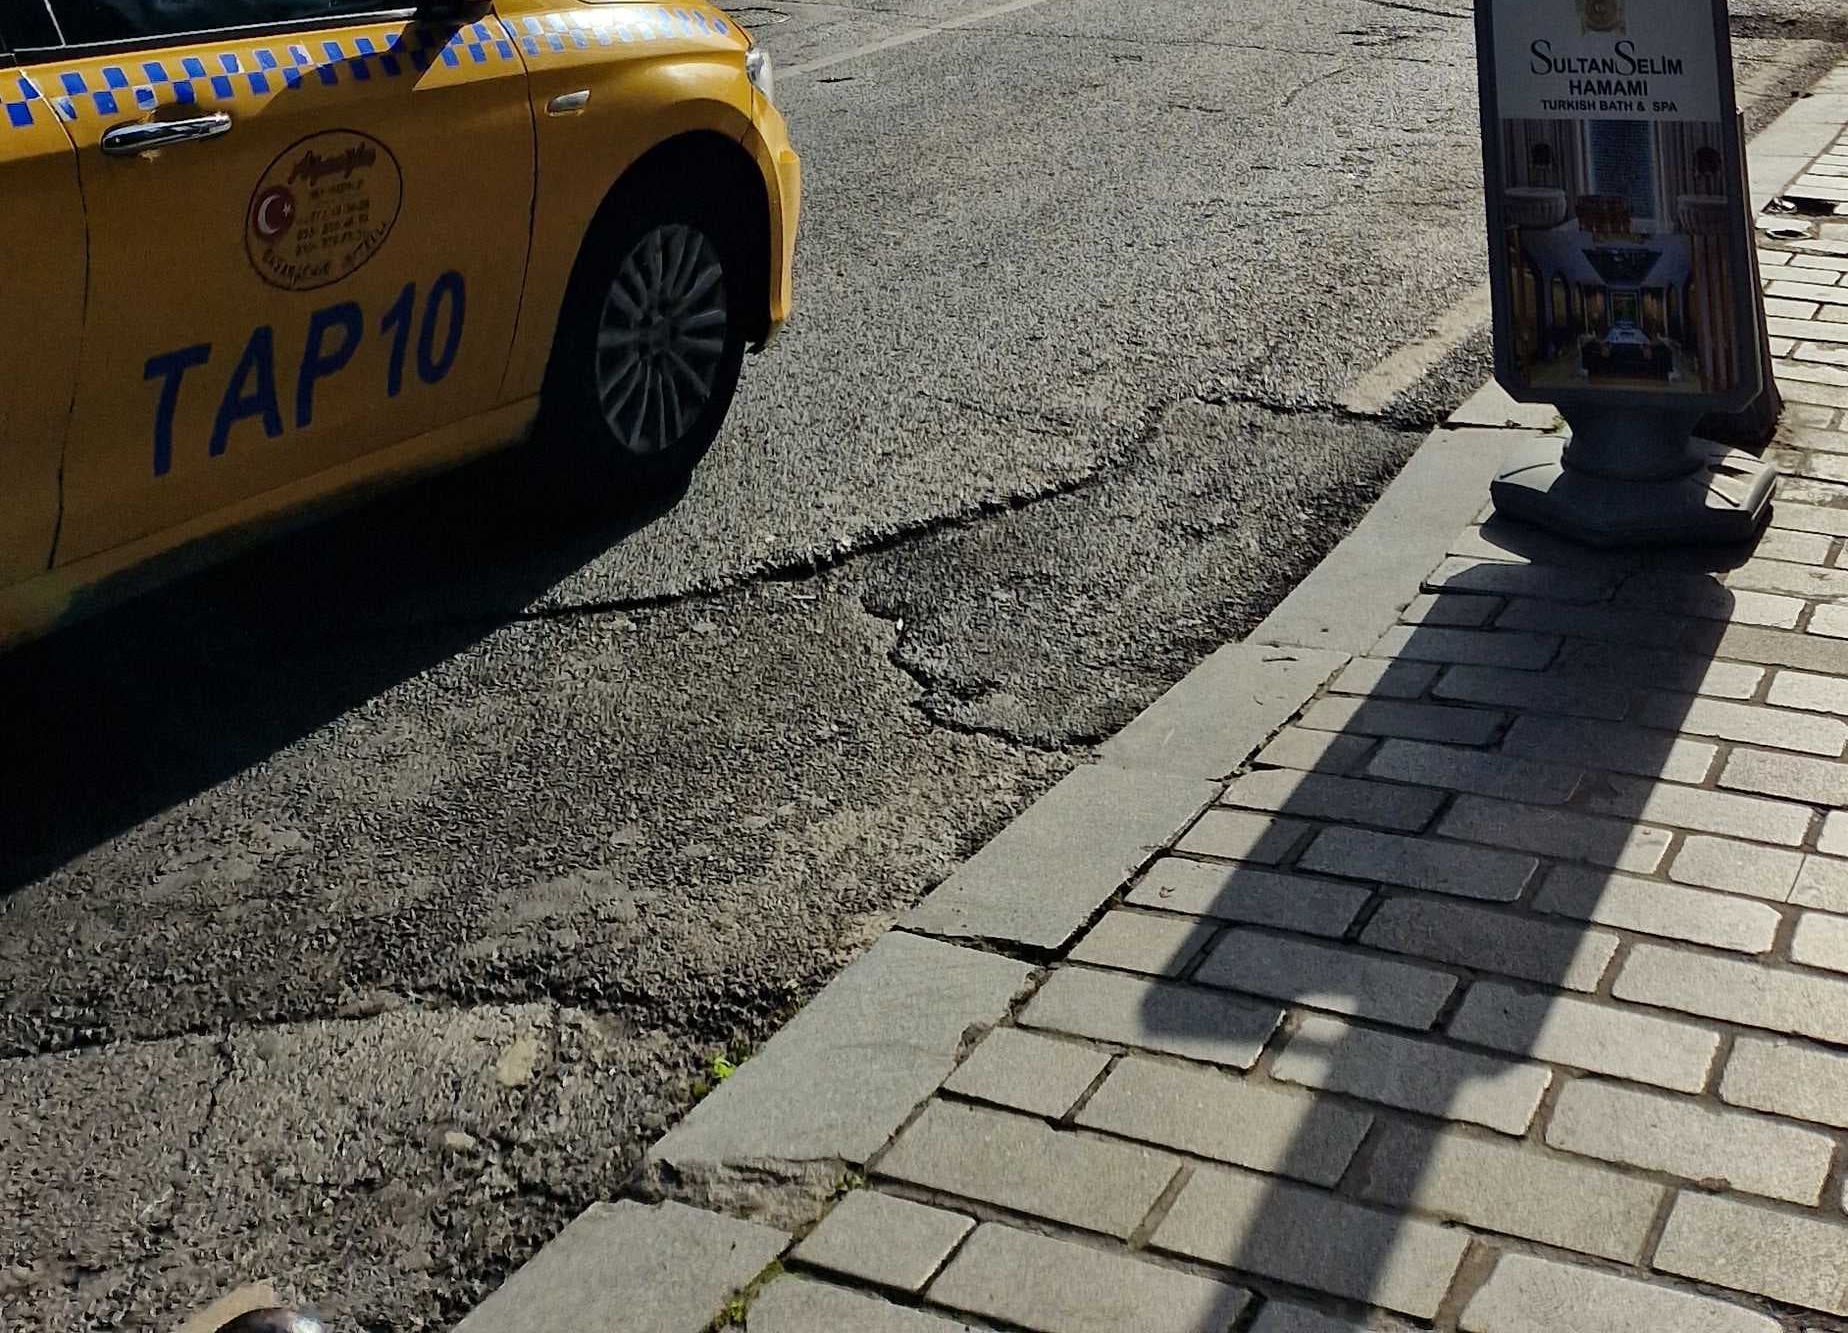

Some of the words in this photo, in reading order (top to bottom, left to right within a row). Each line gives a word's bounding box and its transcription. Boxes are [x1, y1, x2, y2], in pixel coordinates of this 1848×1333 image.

[1569, 80, 1648, 96] HAMAMI
[1541, 99, 1596, 111] TURKISH
[1600, 100, 1633, 112] BATH
[1636, 101, 1645, 112] &
[1653, 101, 1678, 112] SPA
